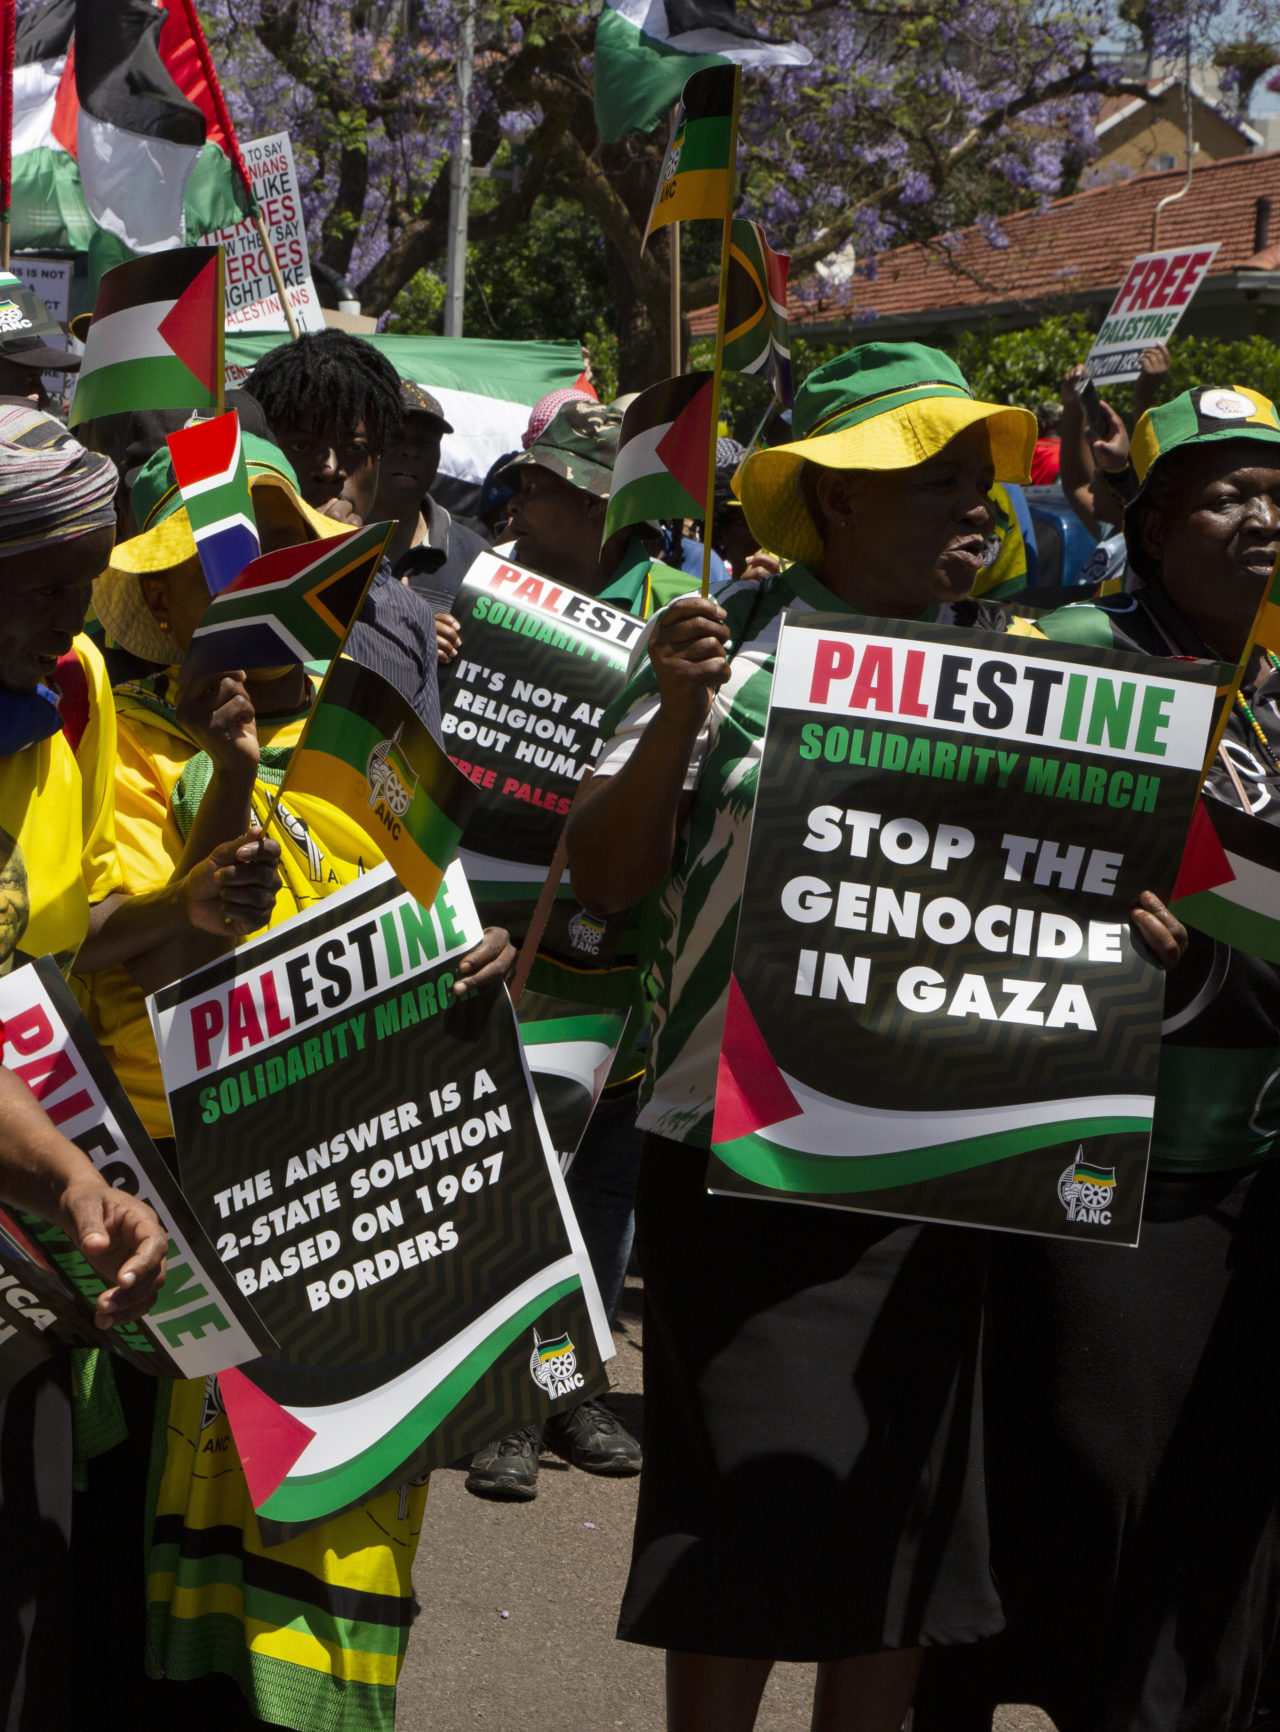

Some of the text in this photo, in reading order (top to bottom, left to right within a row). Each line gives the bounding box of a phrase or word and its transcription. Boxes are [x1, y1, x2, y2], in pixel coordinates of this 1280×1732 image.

[247, 148, 261, 163] TO
[263, 141, 284, 156] SAY
[253, 172, 292, 201] LIKE
[225, 239, 303, 287] EROES
[276, 220, 300, 242] SAY
[26, 268, 38, 277] IS
[41, 270, 65, 280] NOT
[225, 265, 306, 309] IGHT LKE
[1110, 251, 1213, 316] FREE
[1095, 312, 1180, 346] PALESTINE
[472, 596, 602, 662] SOLIDARITY
[455, 660, 568, 714] IT'S NOT
[808, 639, 1177, 757] PALESTINE
[454, 688, 582, 753] RELIGION,
[799, 722, 1162, 815] SOLIDARITY MARCH
[374, 802, 401, 842] ANC
[802, 805, 1125, 898] STOP THE
[576, 940, 599, 957] ANC
[780, 875, 1124, 964] GENOCIDE
[793, 949, 1099, 1033] IN GAZA
[198, 1013, 368, 1126] SOLIDARITY
[213, 1068, 499, 1220] THE ANSWER IS A
[215, 1103, 513, 1264] 2-STATE SOLUTION
[234, 1230, 342, 1297] BASED
[350, 1199, 405, 1242] ON
[414, 1151, 506, 1215] 1967
[1075, 1208, 1112, 1226] ANC
[305, 1221, 461, 1313] BORDERS
[555, 1371, 586, 1397] ANC
